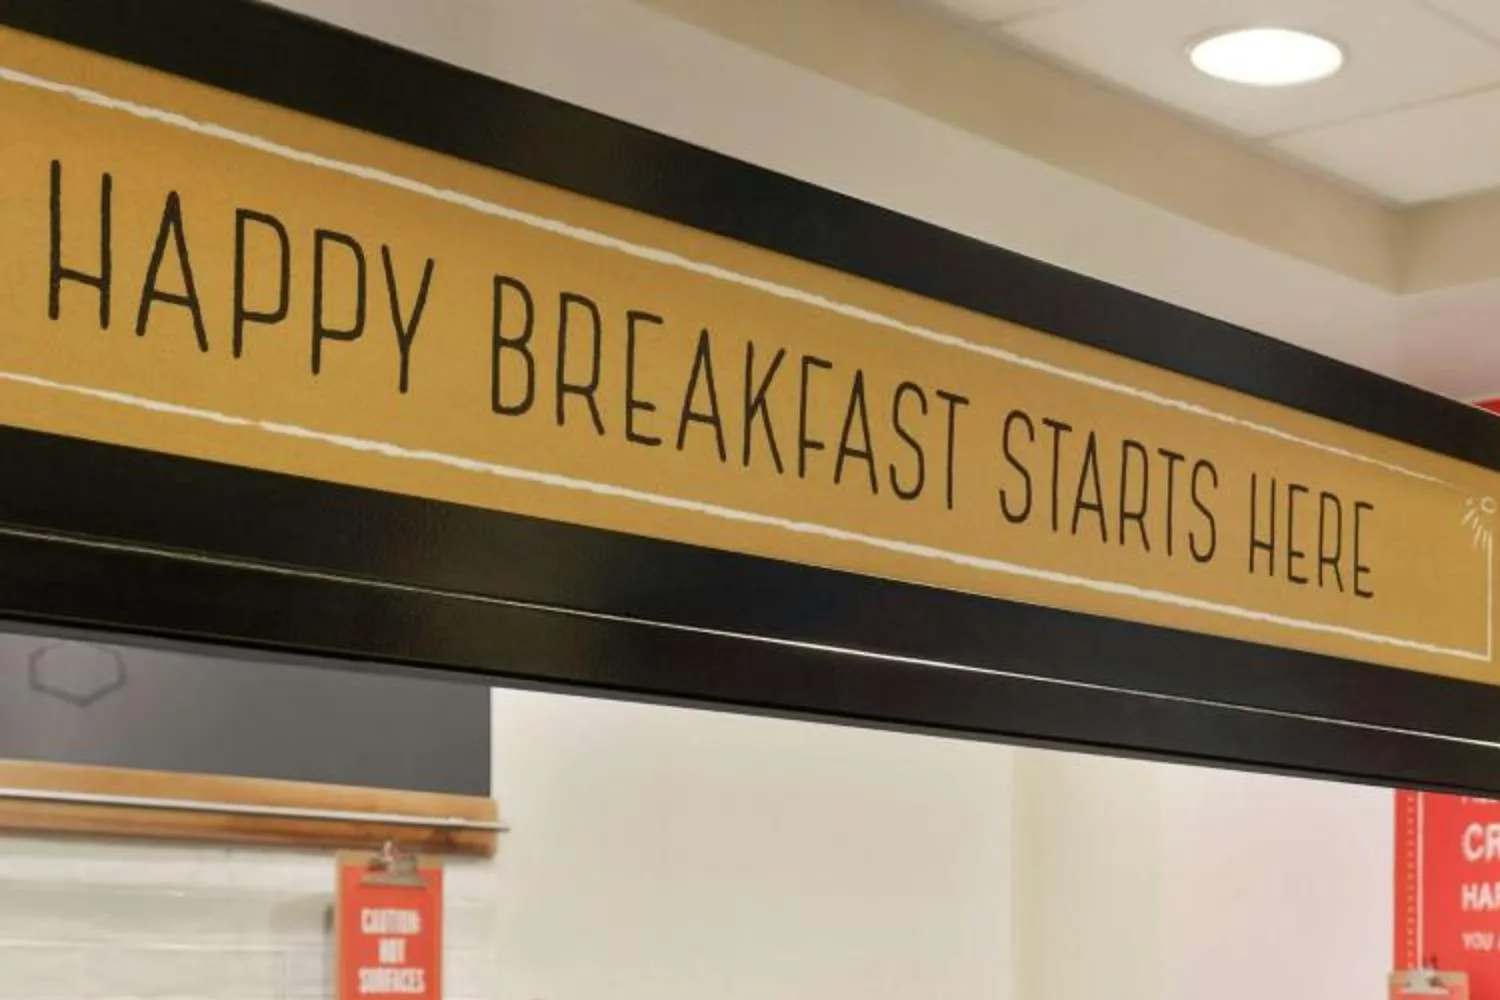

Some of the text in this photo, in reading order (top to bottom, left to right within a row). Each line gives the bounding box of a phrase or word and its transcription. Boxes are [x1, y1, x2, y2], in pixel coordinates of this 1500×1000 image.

[48, 159, 1375, 599] HAPPY BREAKFAST STARTS HERE
